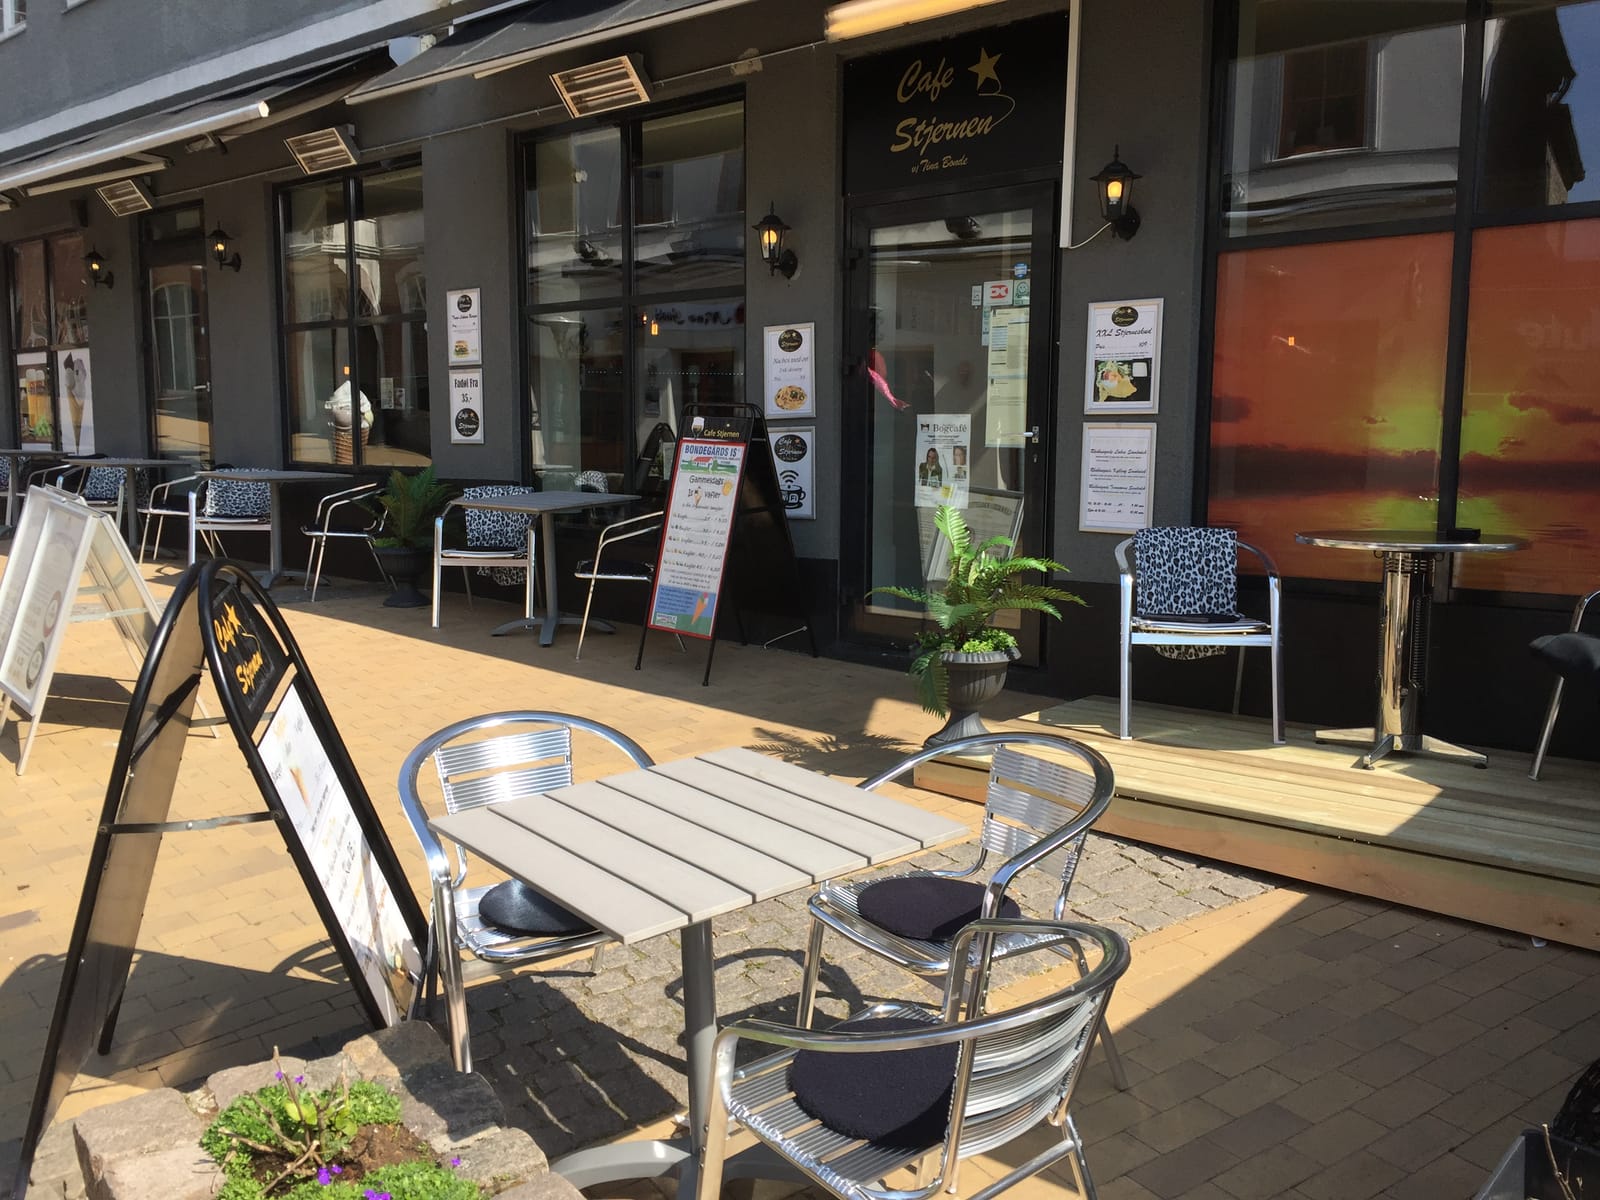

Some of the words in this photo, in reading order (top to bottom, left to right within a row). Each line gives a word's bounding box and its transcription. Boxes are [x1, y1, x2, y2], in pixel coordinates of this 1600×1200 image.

[897, 57, 954, 103] Cafe
[890, 114, 993, 156] Stjernen
[703, 429, 716, 437] Cafe
[716, 429, 740, 439] Stjernen
[932, 423, 968, 434] Bogcafé
